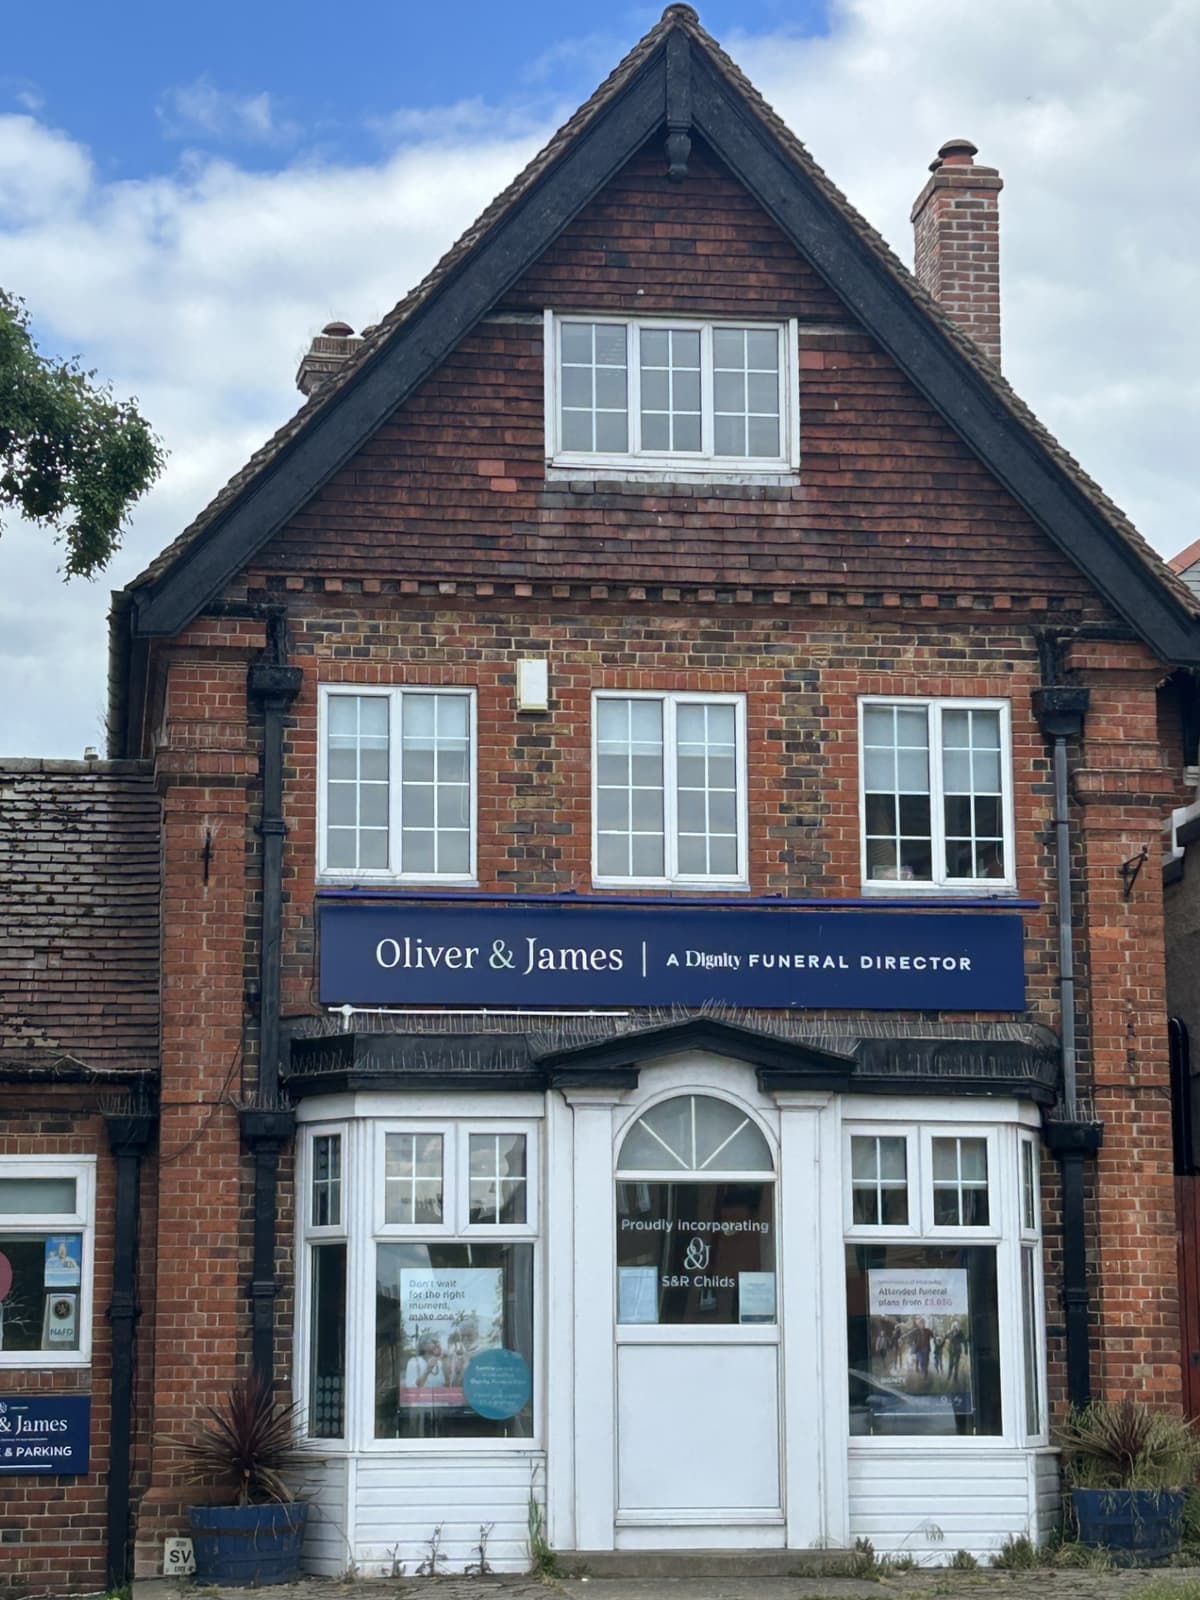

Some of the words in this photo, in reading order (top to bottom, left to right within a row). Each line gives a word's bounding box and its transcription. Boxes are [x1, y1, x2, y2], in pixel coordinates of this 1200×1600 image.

[376, 937, 479, 969] Oliver
[488, 939, 516, 969] &
[523, 937, 623, 975] James
[666, 953, 680, 967] A
[685, 950, 742, 970] Dignity
[748, 954, 849, 969] FUNERAL
[860, 955, 971, 971] DIRECTOR
[621, 1218, 673, 1233] Proudly
[436, 1280, 457, 1288] wait
[661, 1275, 690, 1287] S&R
[693, 1275, 736, 1288] Childs
[425, 1290, 441, 1299] the
[443, 1290, 465, 1301] right
[878, 1287, 917, 1296] Attended
[919, 1287, 947, 1296] funeral
[902, 1298, 923, 1306] from
[0, 1416, 12, 1432] &
[15, 1415, 68, 1435] James
[4, 1447, 13, 1457] &
[16, 1446, 73, 1457] PARKING
[169, 1549, 192, 1564] SV
